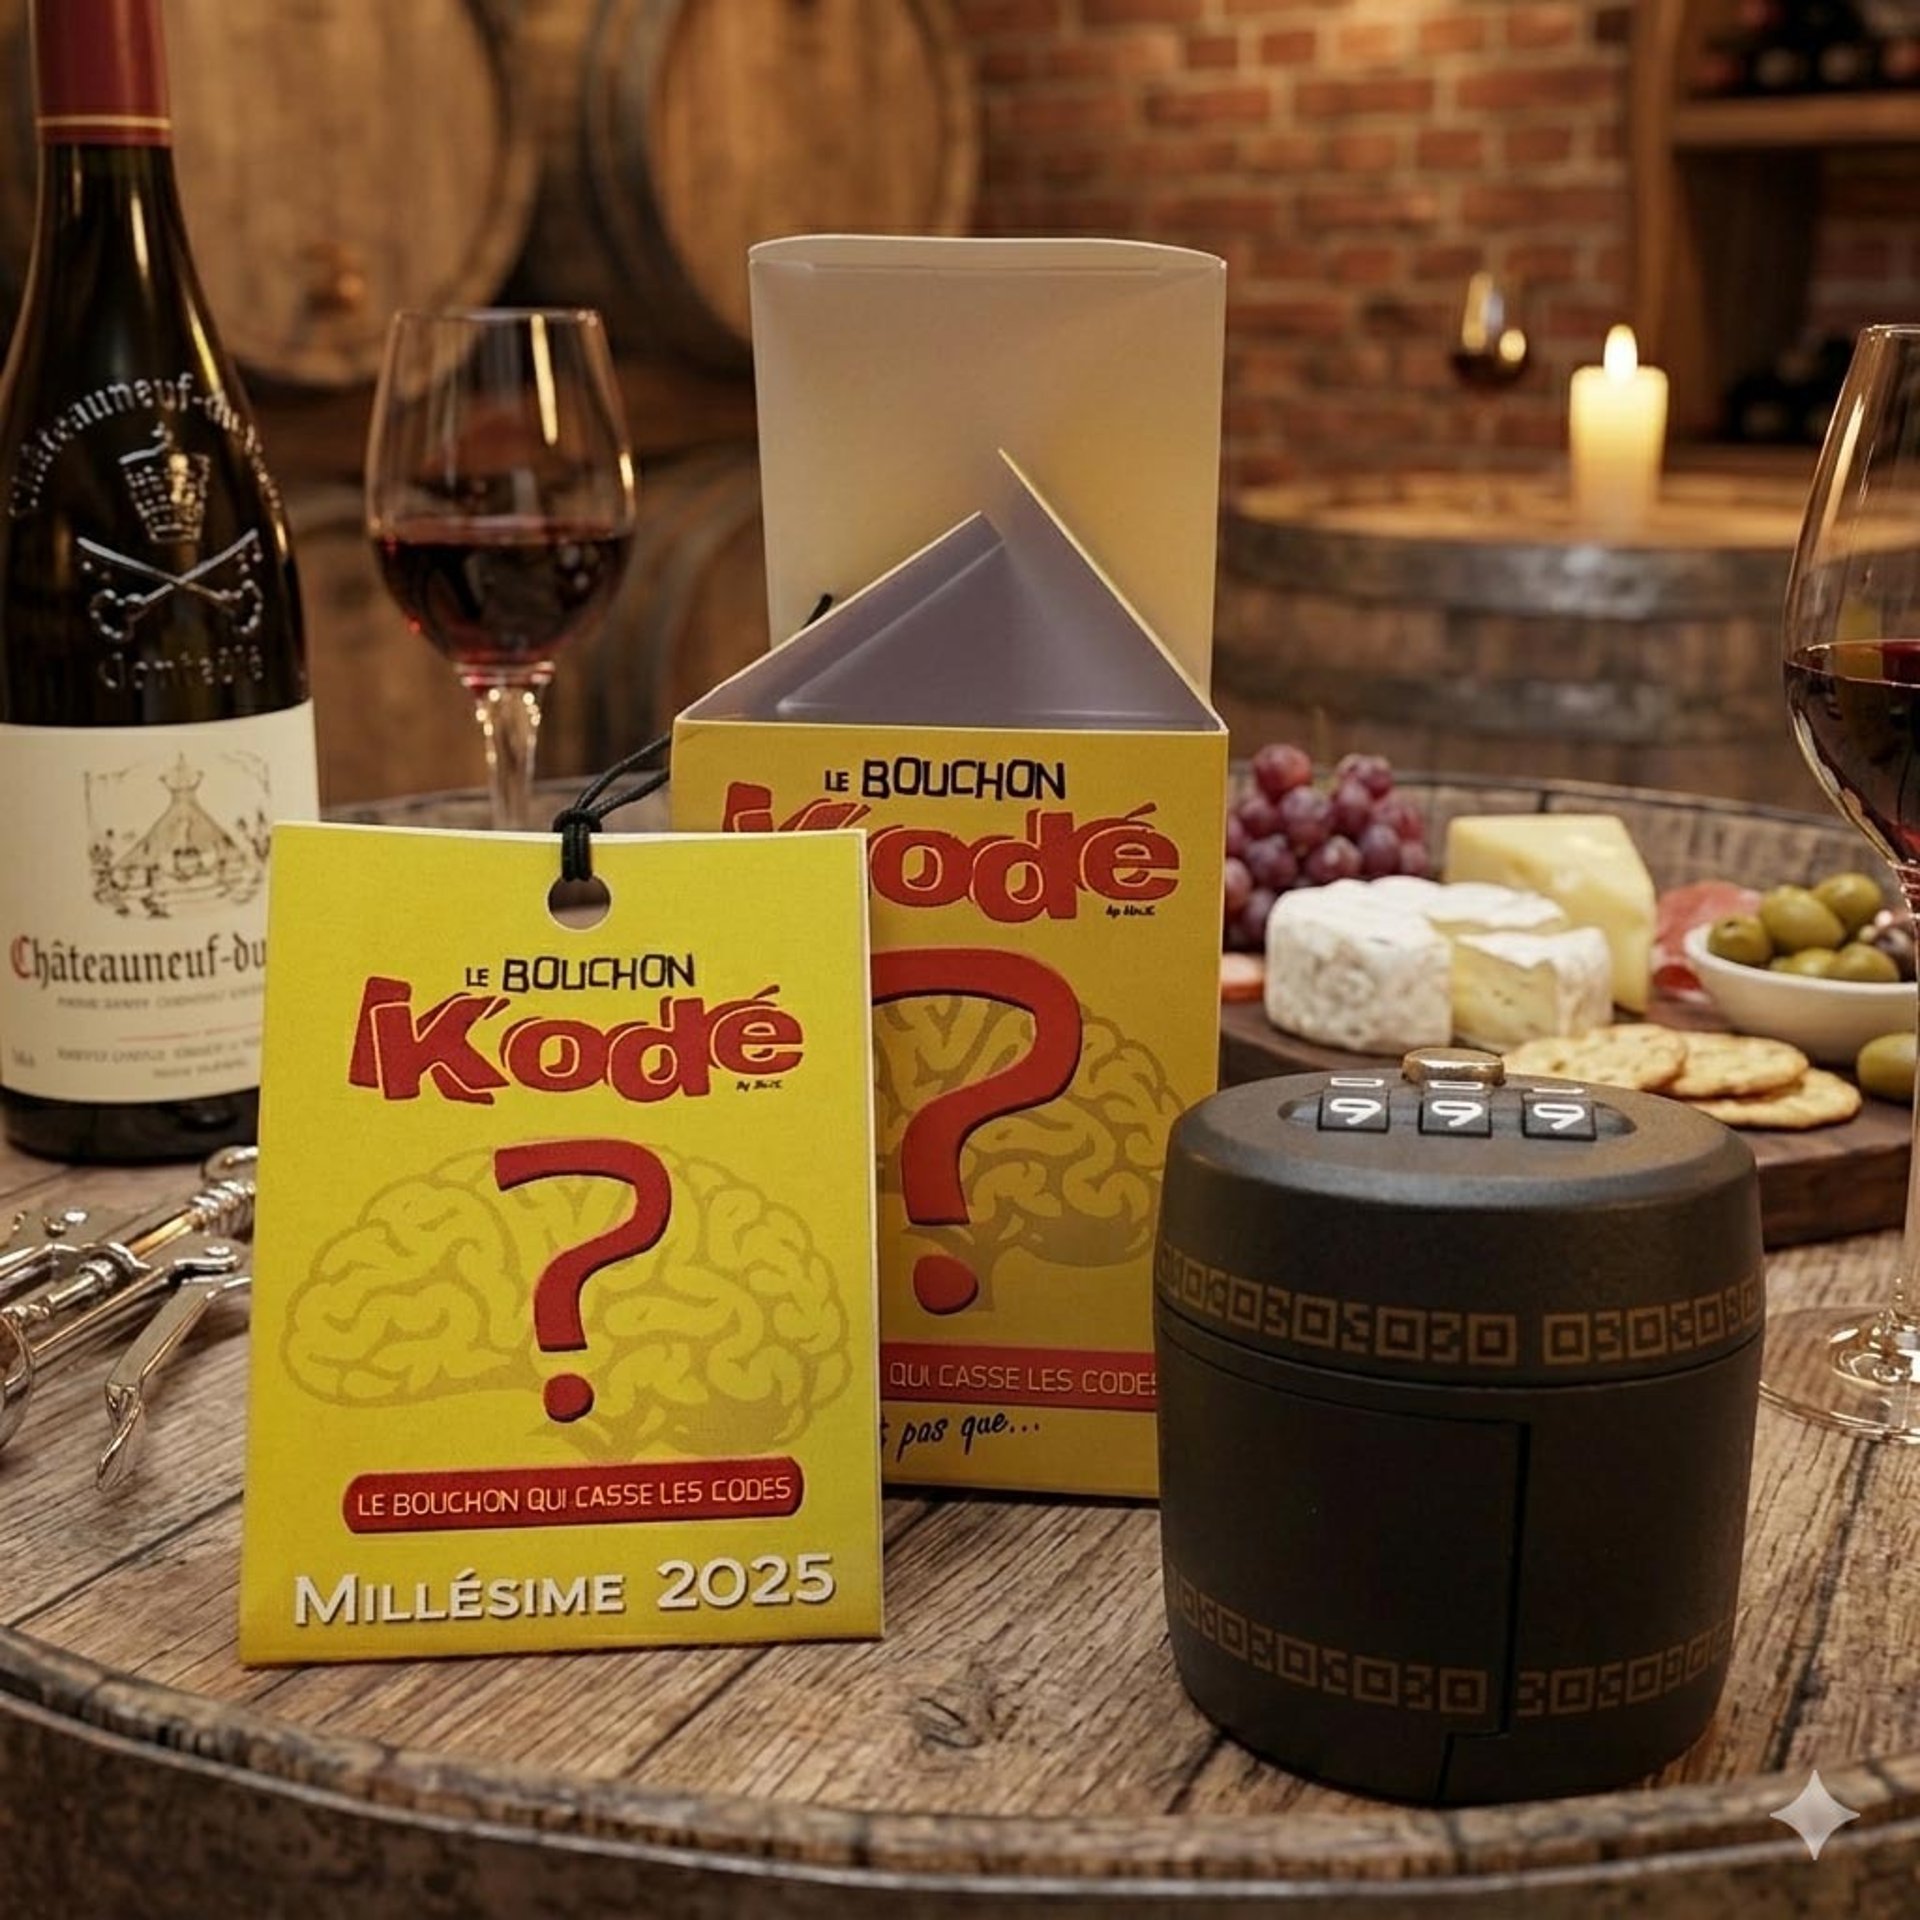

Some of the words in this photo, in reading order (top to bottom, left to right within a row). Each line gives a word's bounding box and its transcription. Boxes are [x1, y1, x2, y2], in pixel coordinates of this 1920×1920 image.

[825, 770, 849, 793] LE
[861, 756, 1066, 800] BOUCHON
[466, 967, 489, 988] LE
[502, 954, 696, 993] BOUCHON
[348, 976, 804, 1105] Kodé
[889, 1362, 930, 1388] QUI
[939, 1364, 1021, 1391] CASSE
[1028, 1367, 1074, 1392] LES
[896, 1416, 949, 1464] pas
[961, 1412, 1041, 1456] que...
[358, 1494, 386, 1517] LE
[393, 1489, 519, 1517] BOUCHON
[527, 1487, 567, 1514] QUI
[575, 1483, 653, 1509] CASSE
[660, 1481, 703, 1506] LES
[712, 1477, 792, 1502] CODES
[656, 1553, 836, 1610] 2025
